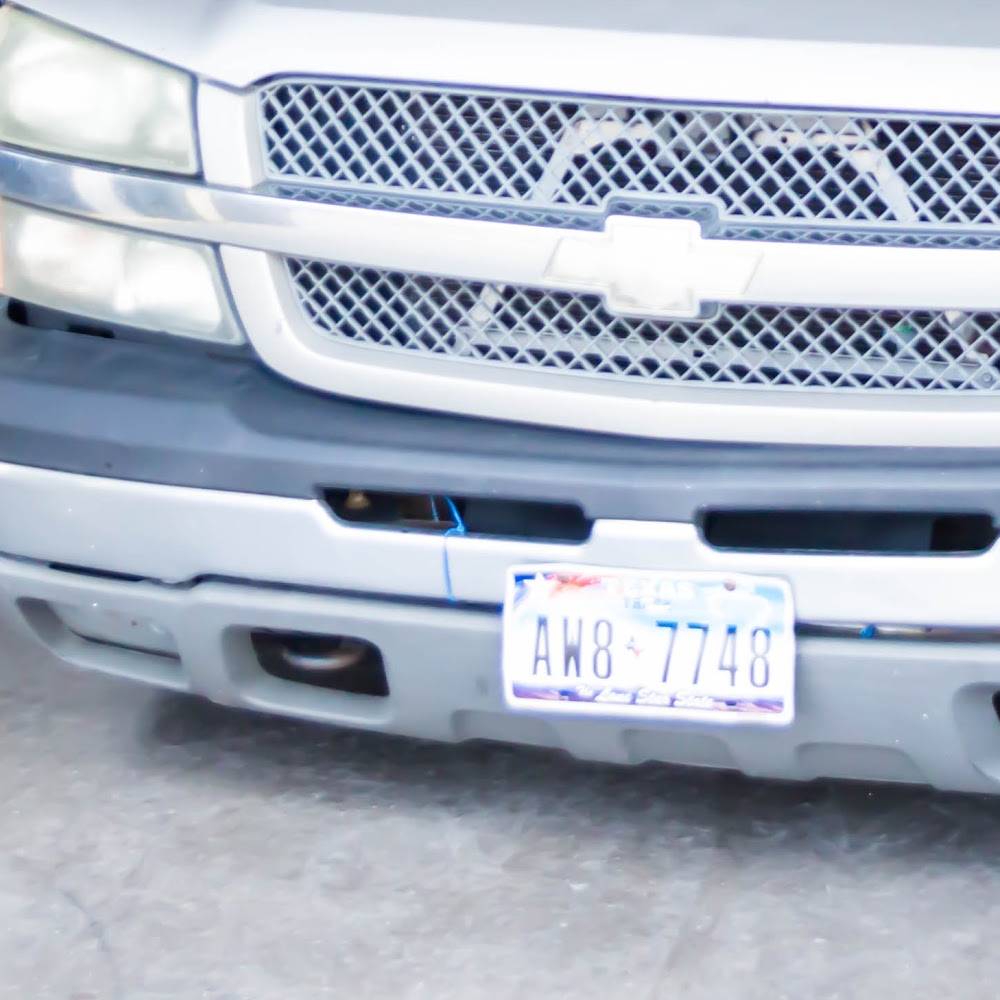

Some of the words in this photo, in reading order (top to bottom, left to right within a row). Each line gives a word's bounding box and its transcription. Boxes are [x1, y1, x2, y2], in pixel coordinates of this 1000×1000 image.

[607, 577, 694, 600] TEXAS
[532, 614, 614, 680] AW8
[655, 620, 772, 688] 7748
